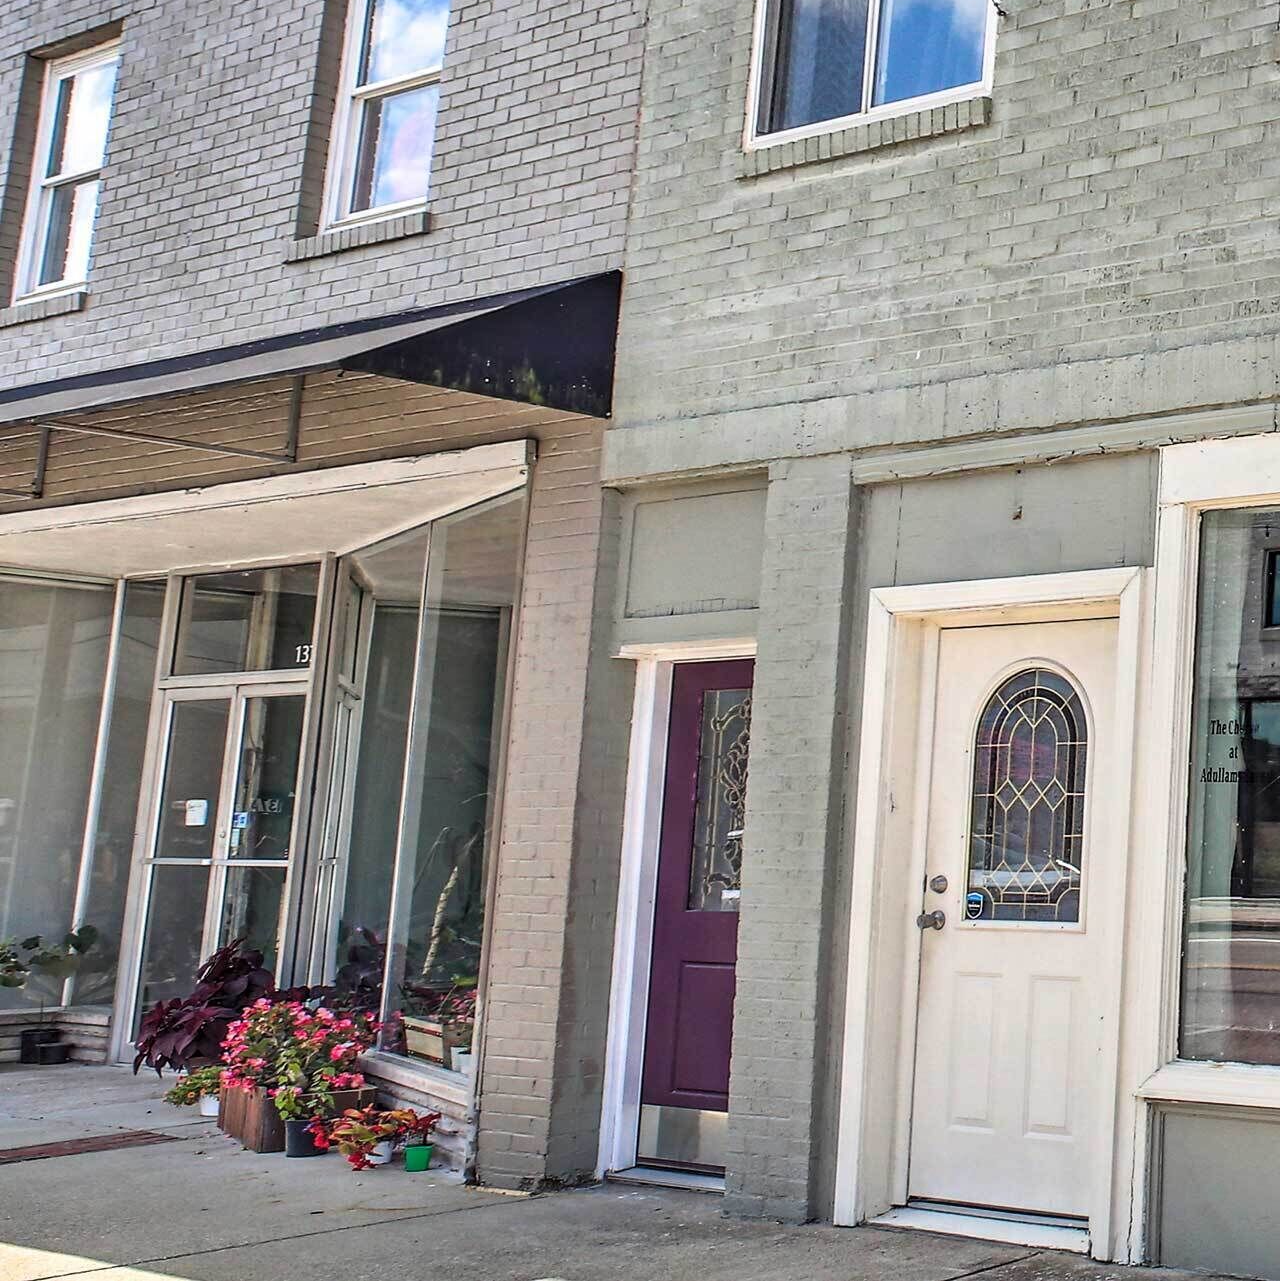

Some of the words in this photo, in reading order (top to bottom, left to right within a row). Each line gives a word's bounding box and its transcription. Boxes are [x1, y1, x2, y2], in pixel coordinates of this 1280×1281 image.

[295, 644, 313, 663] 13
[1210, 720, 1227, 735] The
[1228, 746, 1239, 759] at
